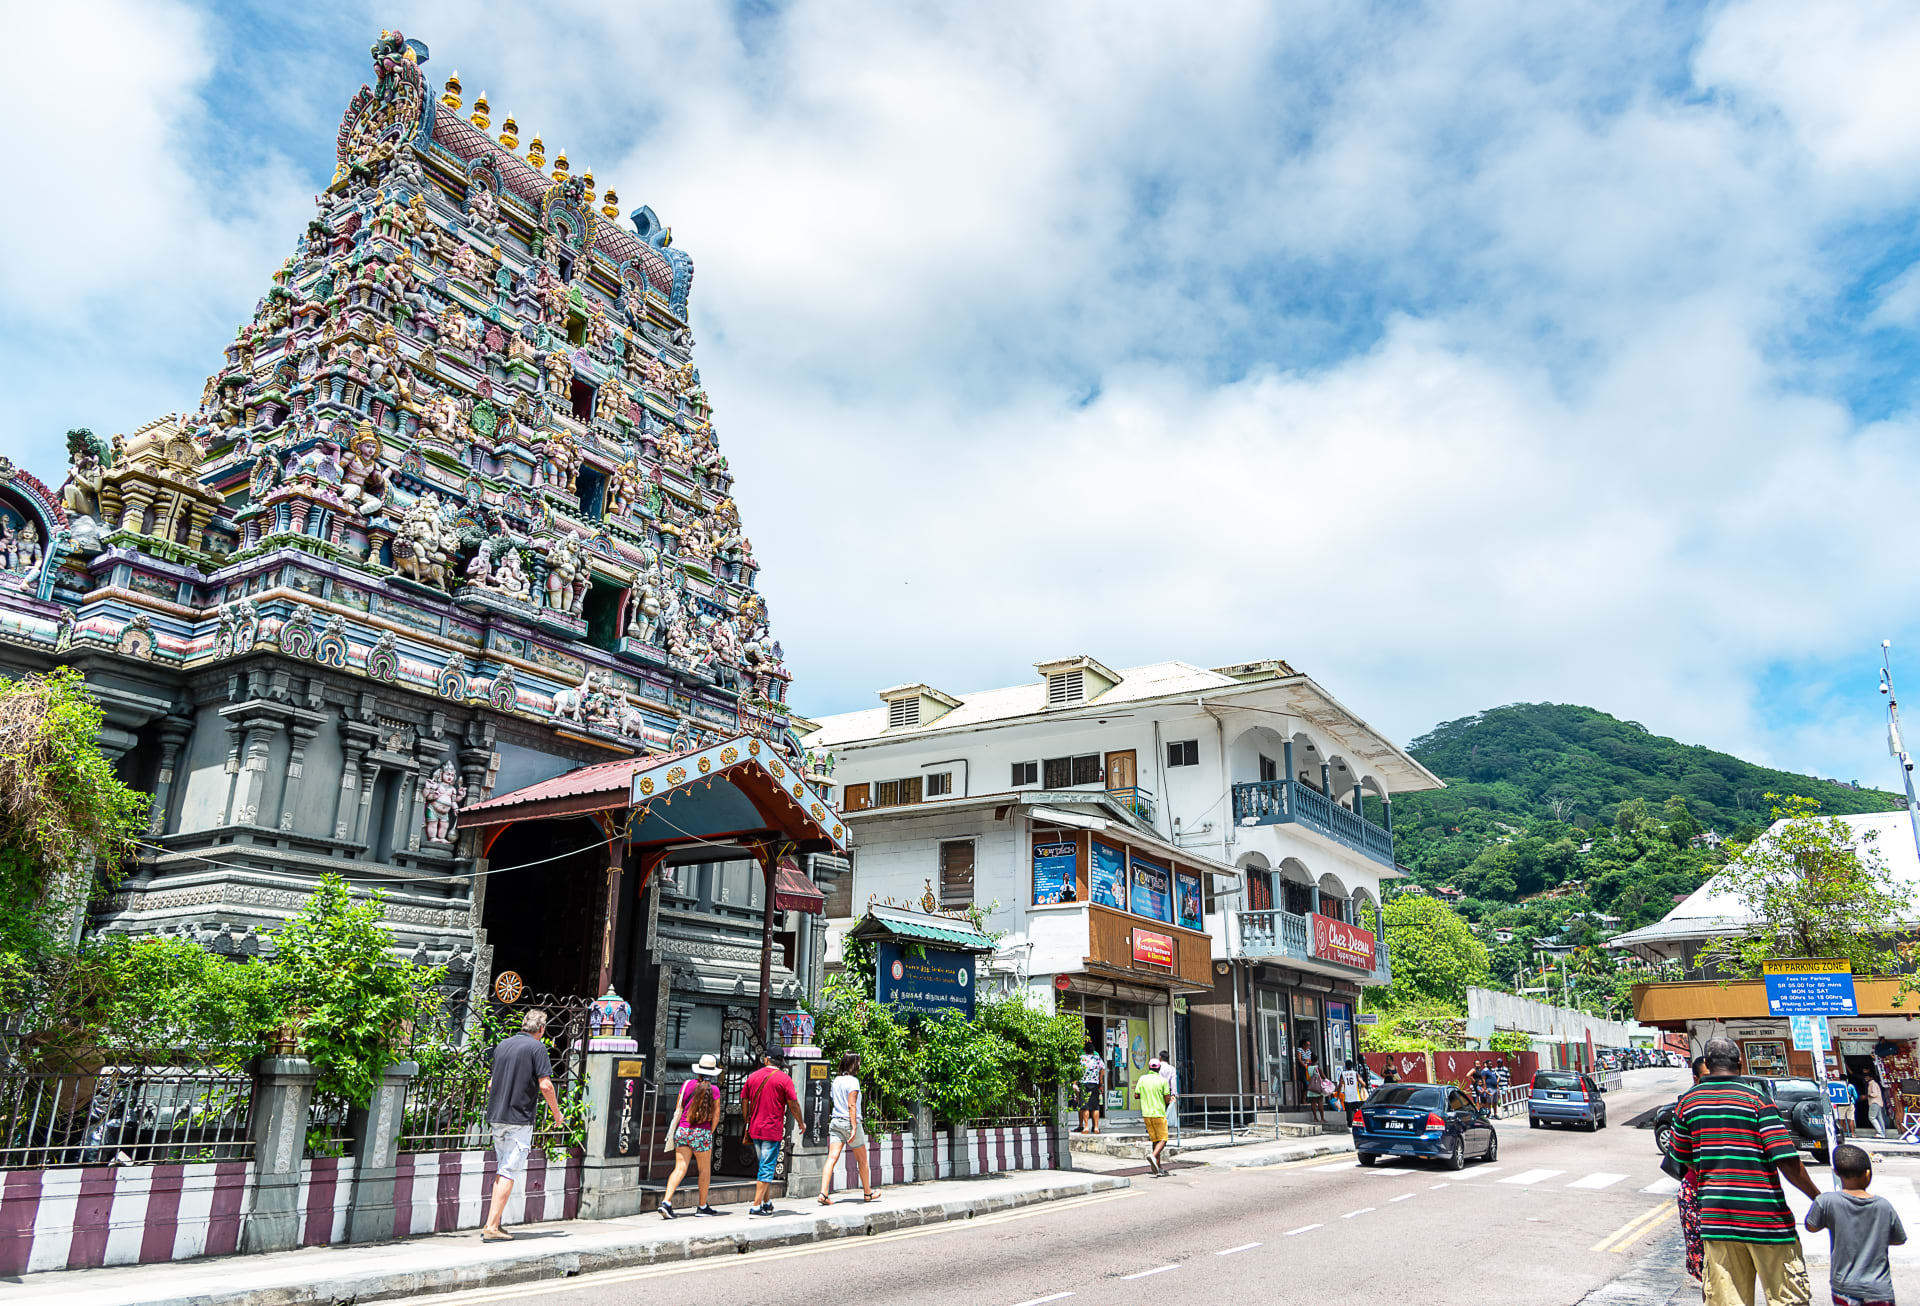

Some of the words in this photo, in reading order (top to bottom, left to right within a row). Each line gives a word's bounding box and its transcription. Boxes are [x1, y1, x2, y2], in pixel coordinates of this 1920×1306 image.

[1328, 923, 1346, 947] Chez
[1768, 963, 1783, 972] PAY
[1785, 962, 1820, 972] PARKING
[1822, 961, 1845, 971] ZONE
[1346, 1077, 1355, 1086] 16
[1829, 1087, 1845, 1098] UT
